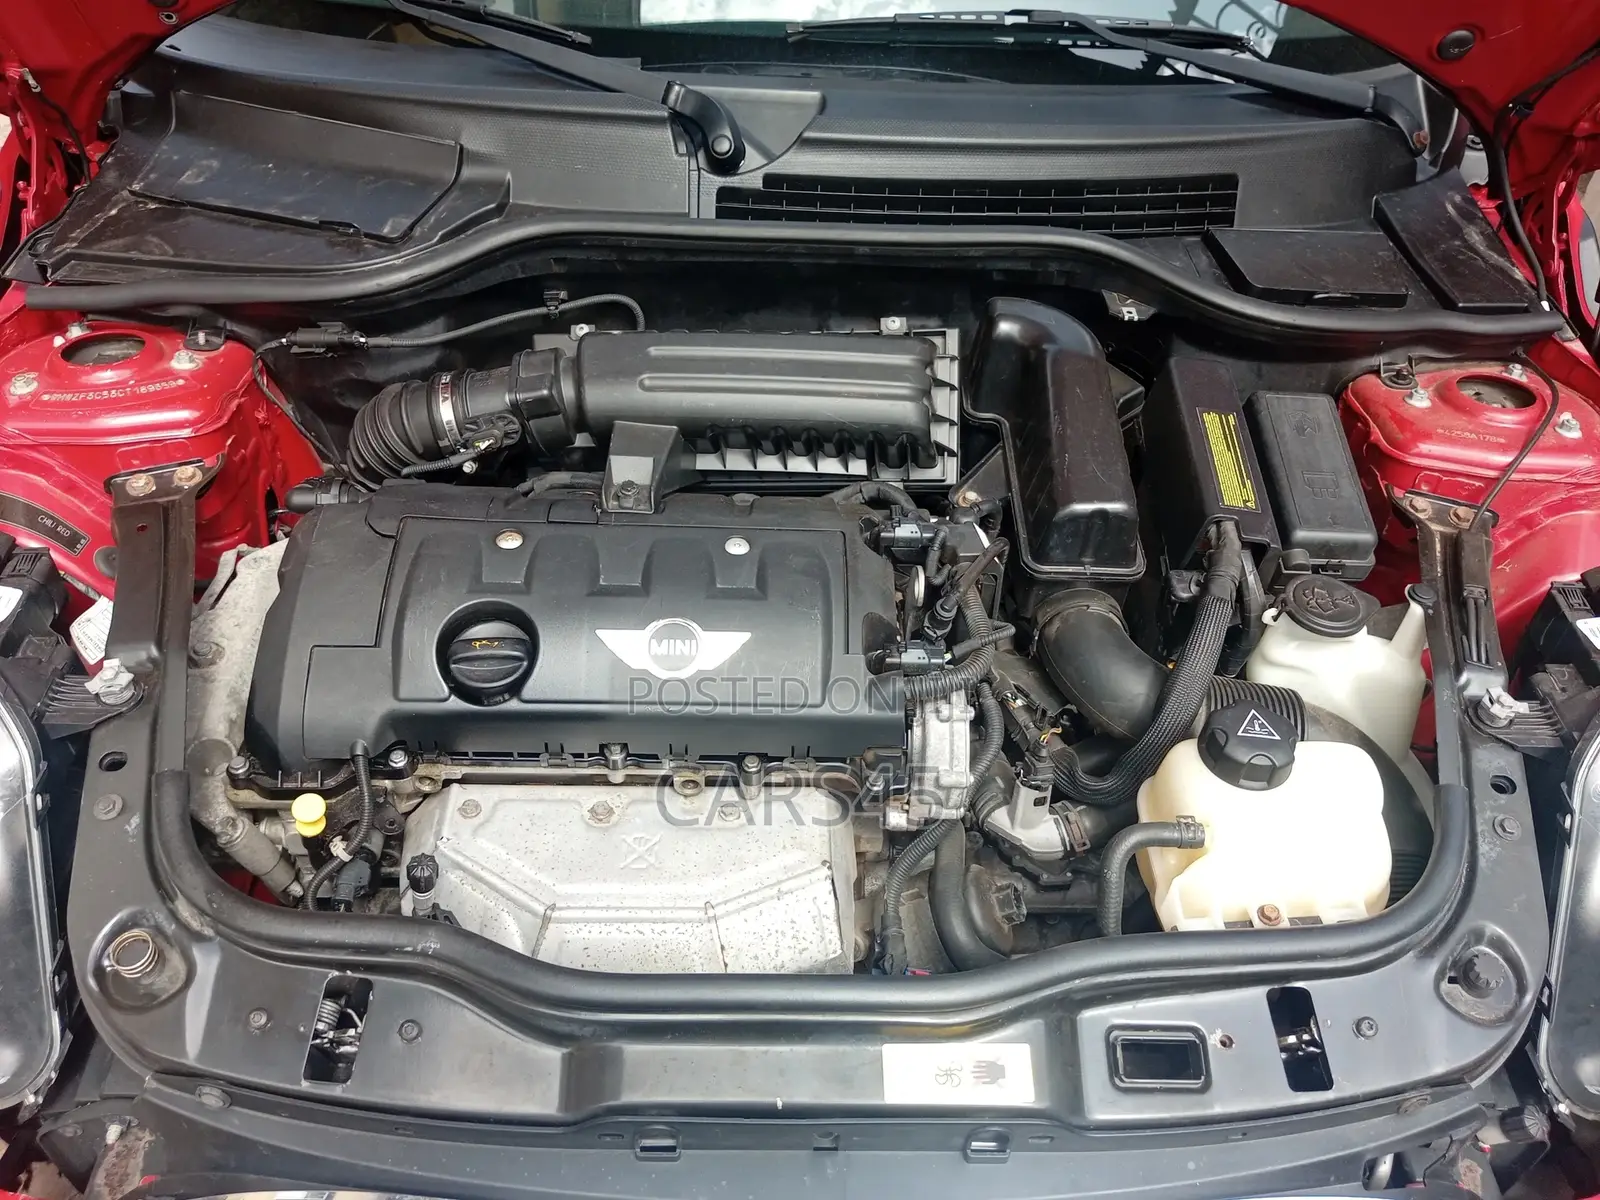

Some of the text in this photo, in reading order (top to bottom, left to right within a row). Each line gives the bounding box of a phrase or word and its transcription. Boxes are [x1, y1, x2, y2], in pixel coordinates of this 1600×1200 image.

[37, 515, 71, 538] CHILI RED
[650, 638, 697, 656] MINI
